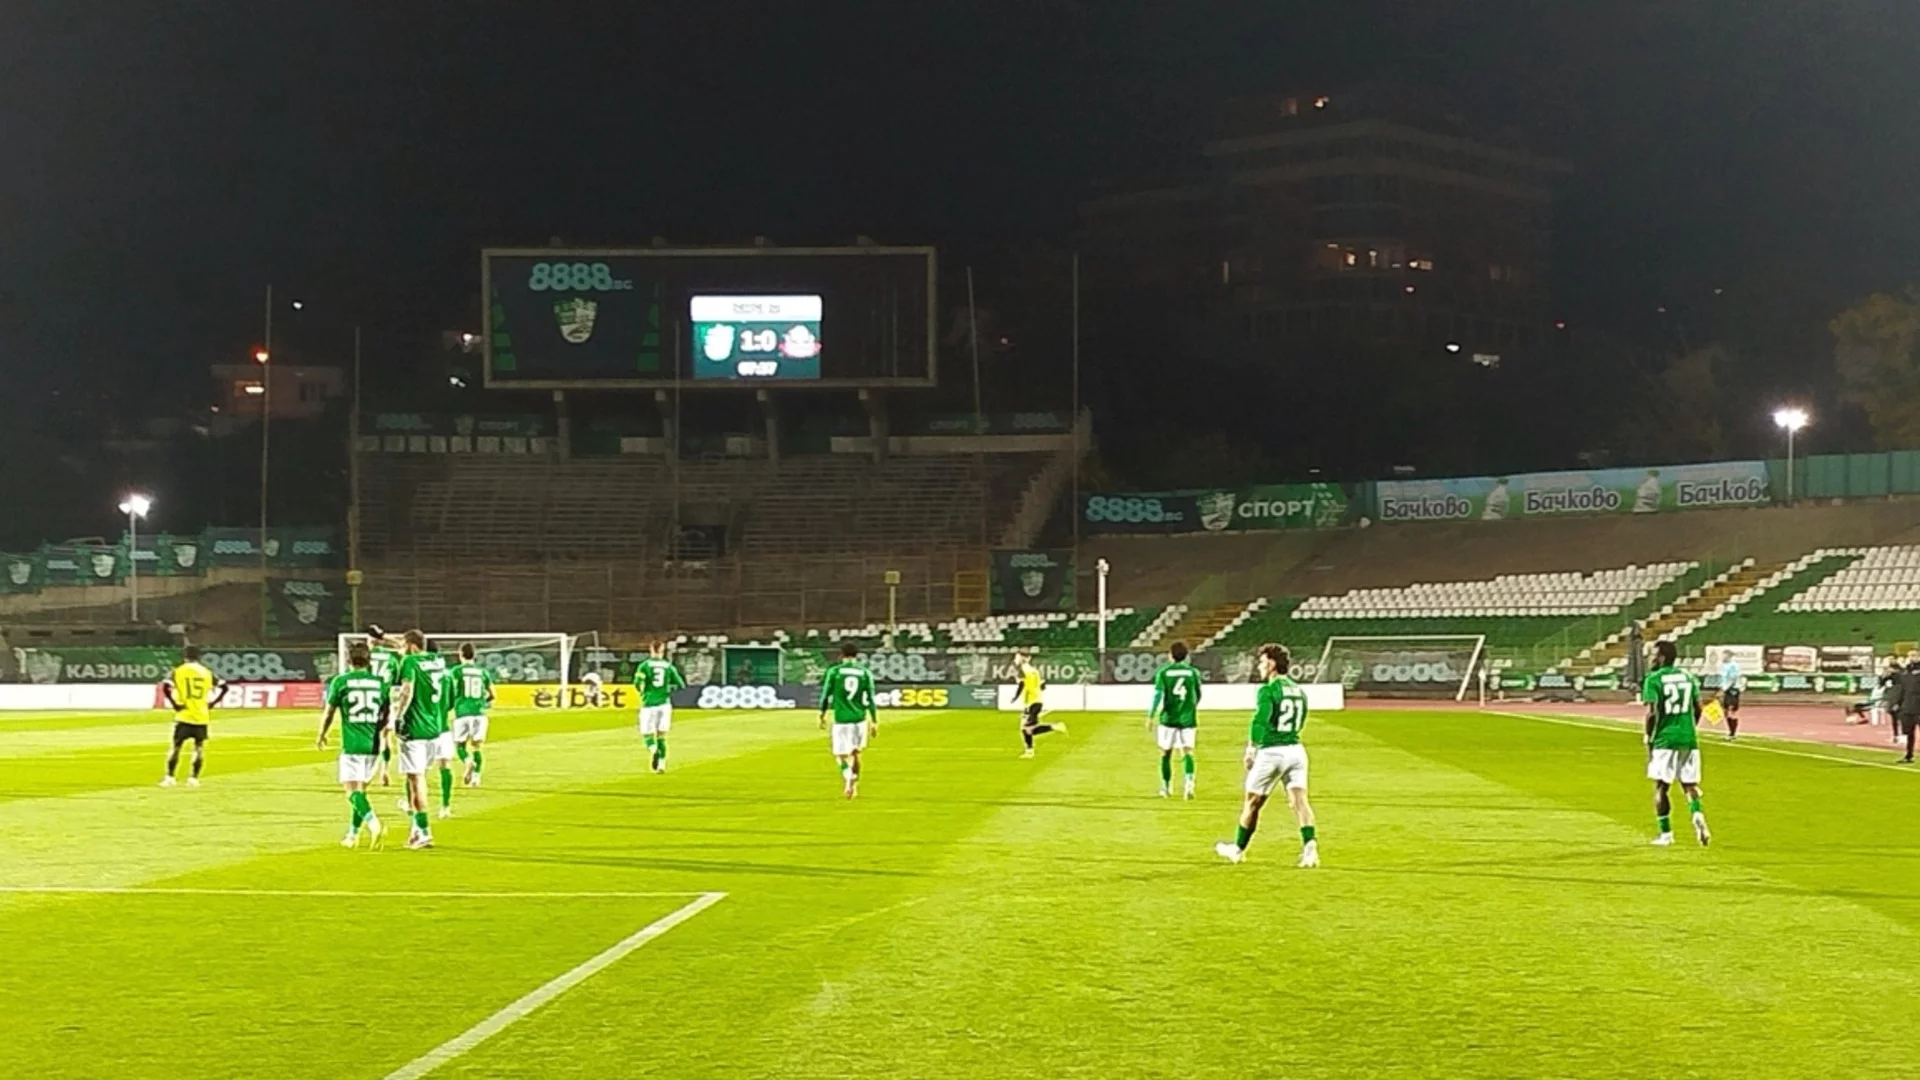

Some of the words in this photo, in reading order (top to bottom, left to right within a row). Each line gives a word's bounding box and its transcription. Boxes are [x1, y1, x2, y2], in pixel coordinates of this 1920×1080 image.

[739, 329, 778, 353] 1:0
[1238, 498, 1315, 518] СПОРТ
[1382, 497, 1469, 520] Бачково
[1526, 487, 1619, 513] Бачково
[66, 663, 159, 679] КАЗИНО
[652, 667, 666, 688] 3
[184, 677, 205, 700] 15
[462, 676, 483, 699] 18
[844, 676, 859, 701] 9
[1172, 677, 1187, 701] 4
[1663, 681, 1693, 715] 27
[347, 690, 381, 724] 25
[1277, 698, 1305, 732] 21
